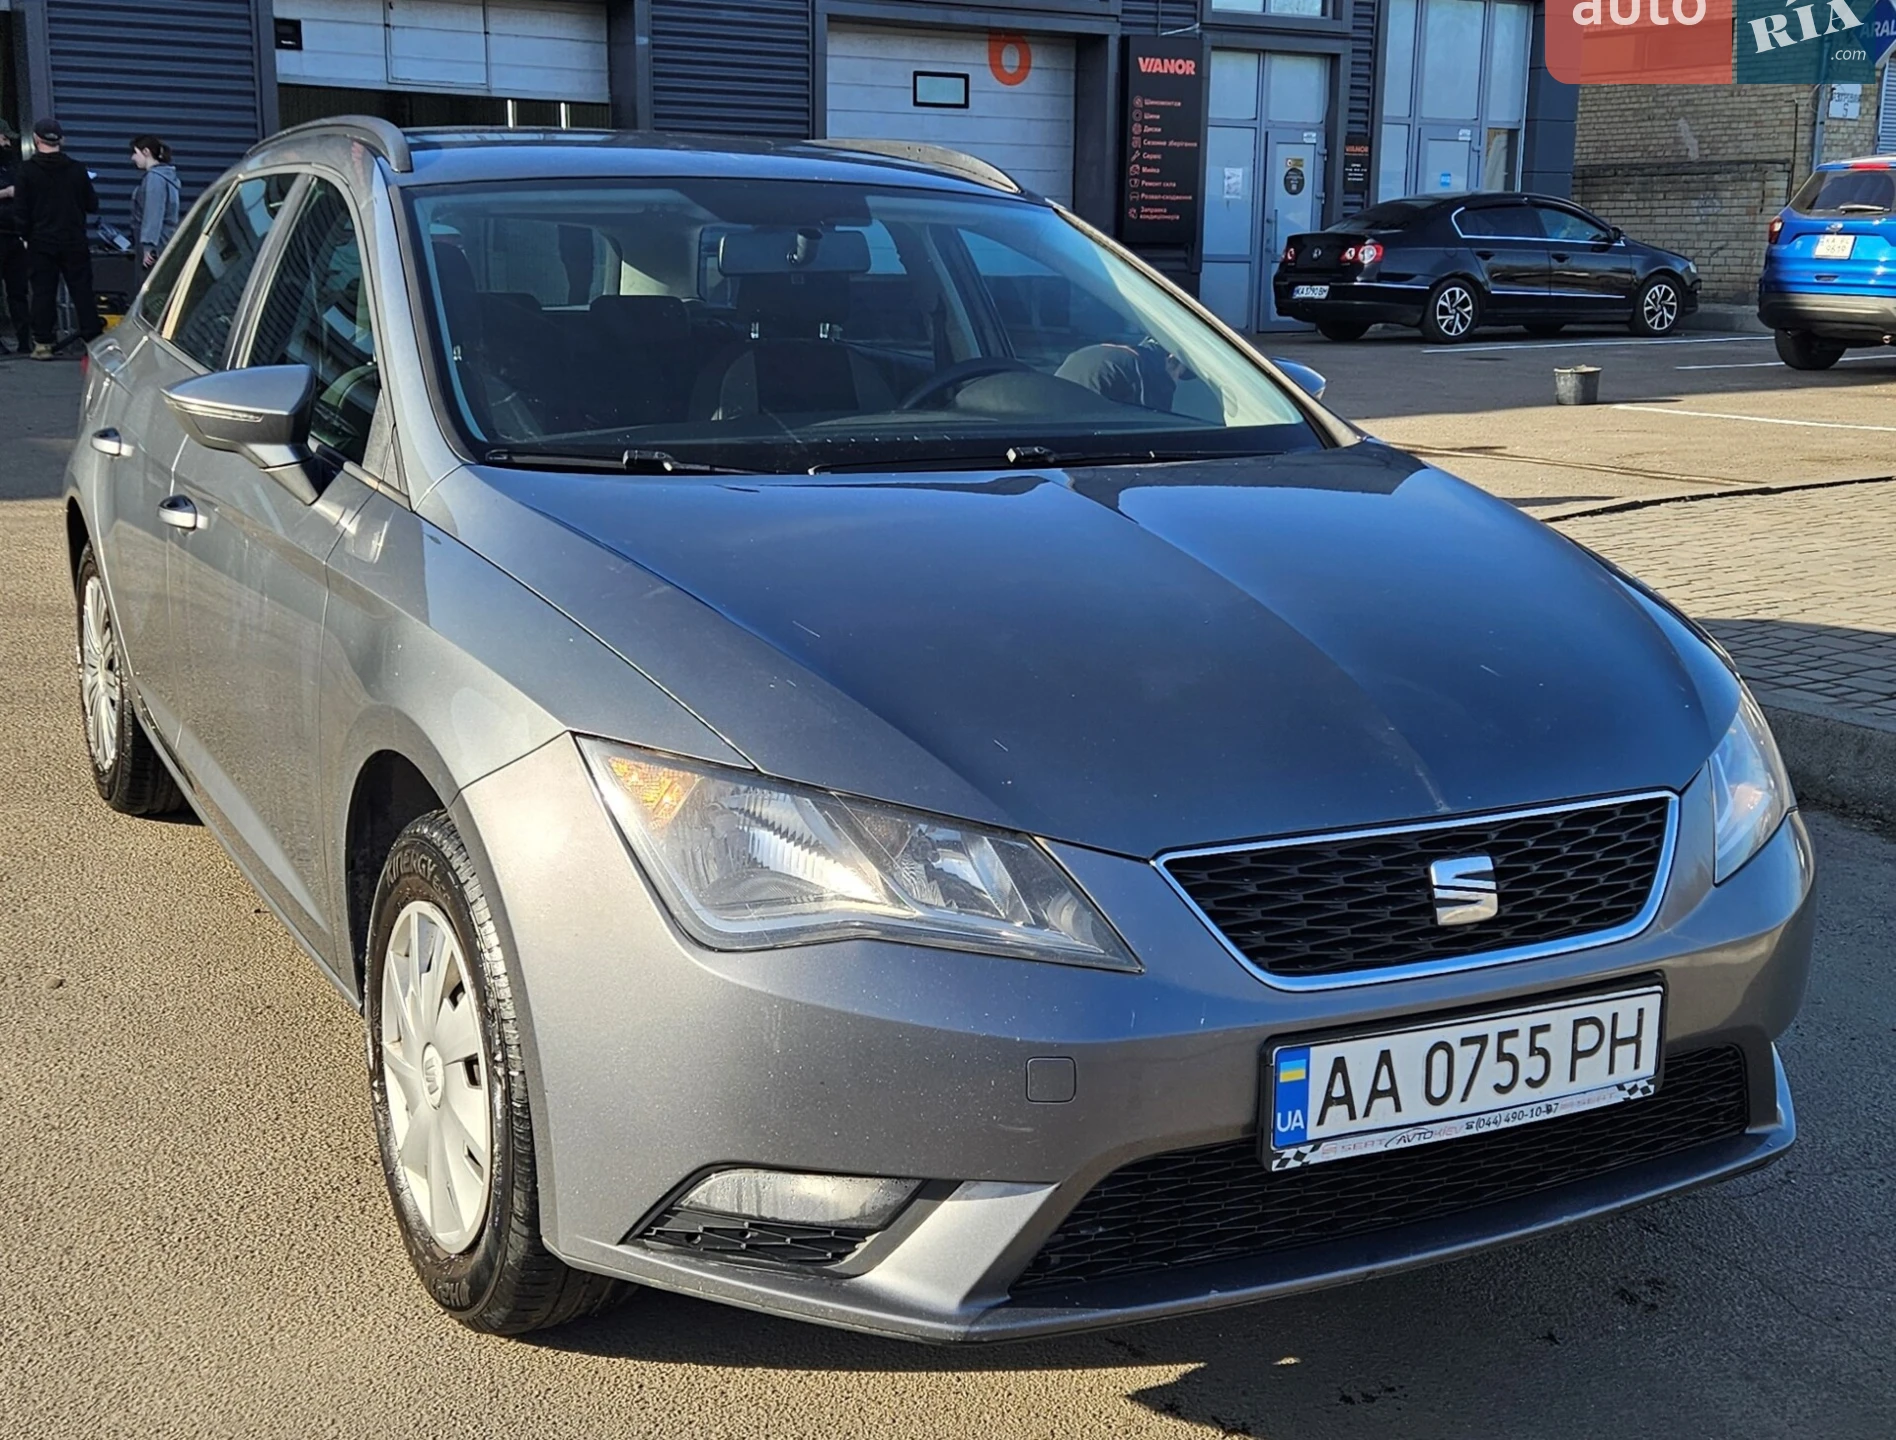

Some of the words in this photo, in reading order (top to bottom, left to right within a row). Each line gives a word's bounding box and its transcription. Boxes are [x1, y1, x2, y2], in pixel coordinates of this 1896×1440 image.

[1137, 56, 1196, 75] VIANOR
[1316, 1048, 1402, 1127] AA
[1425, 1023, 1552, 1106] 0755
[1569, 1008, 1645, 1083] PH
[1277, 1109, 1305, 1133] UA
[1475, 1113, 1502, 1131] (044)
